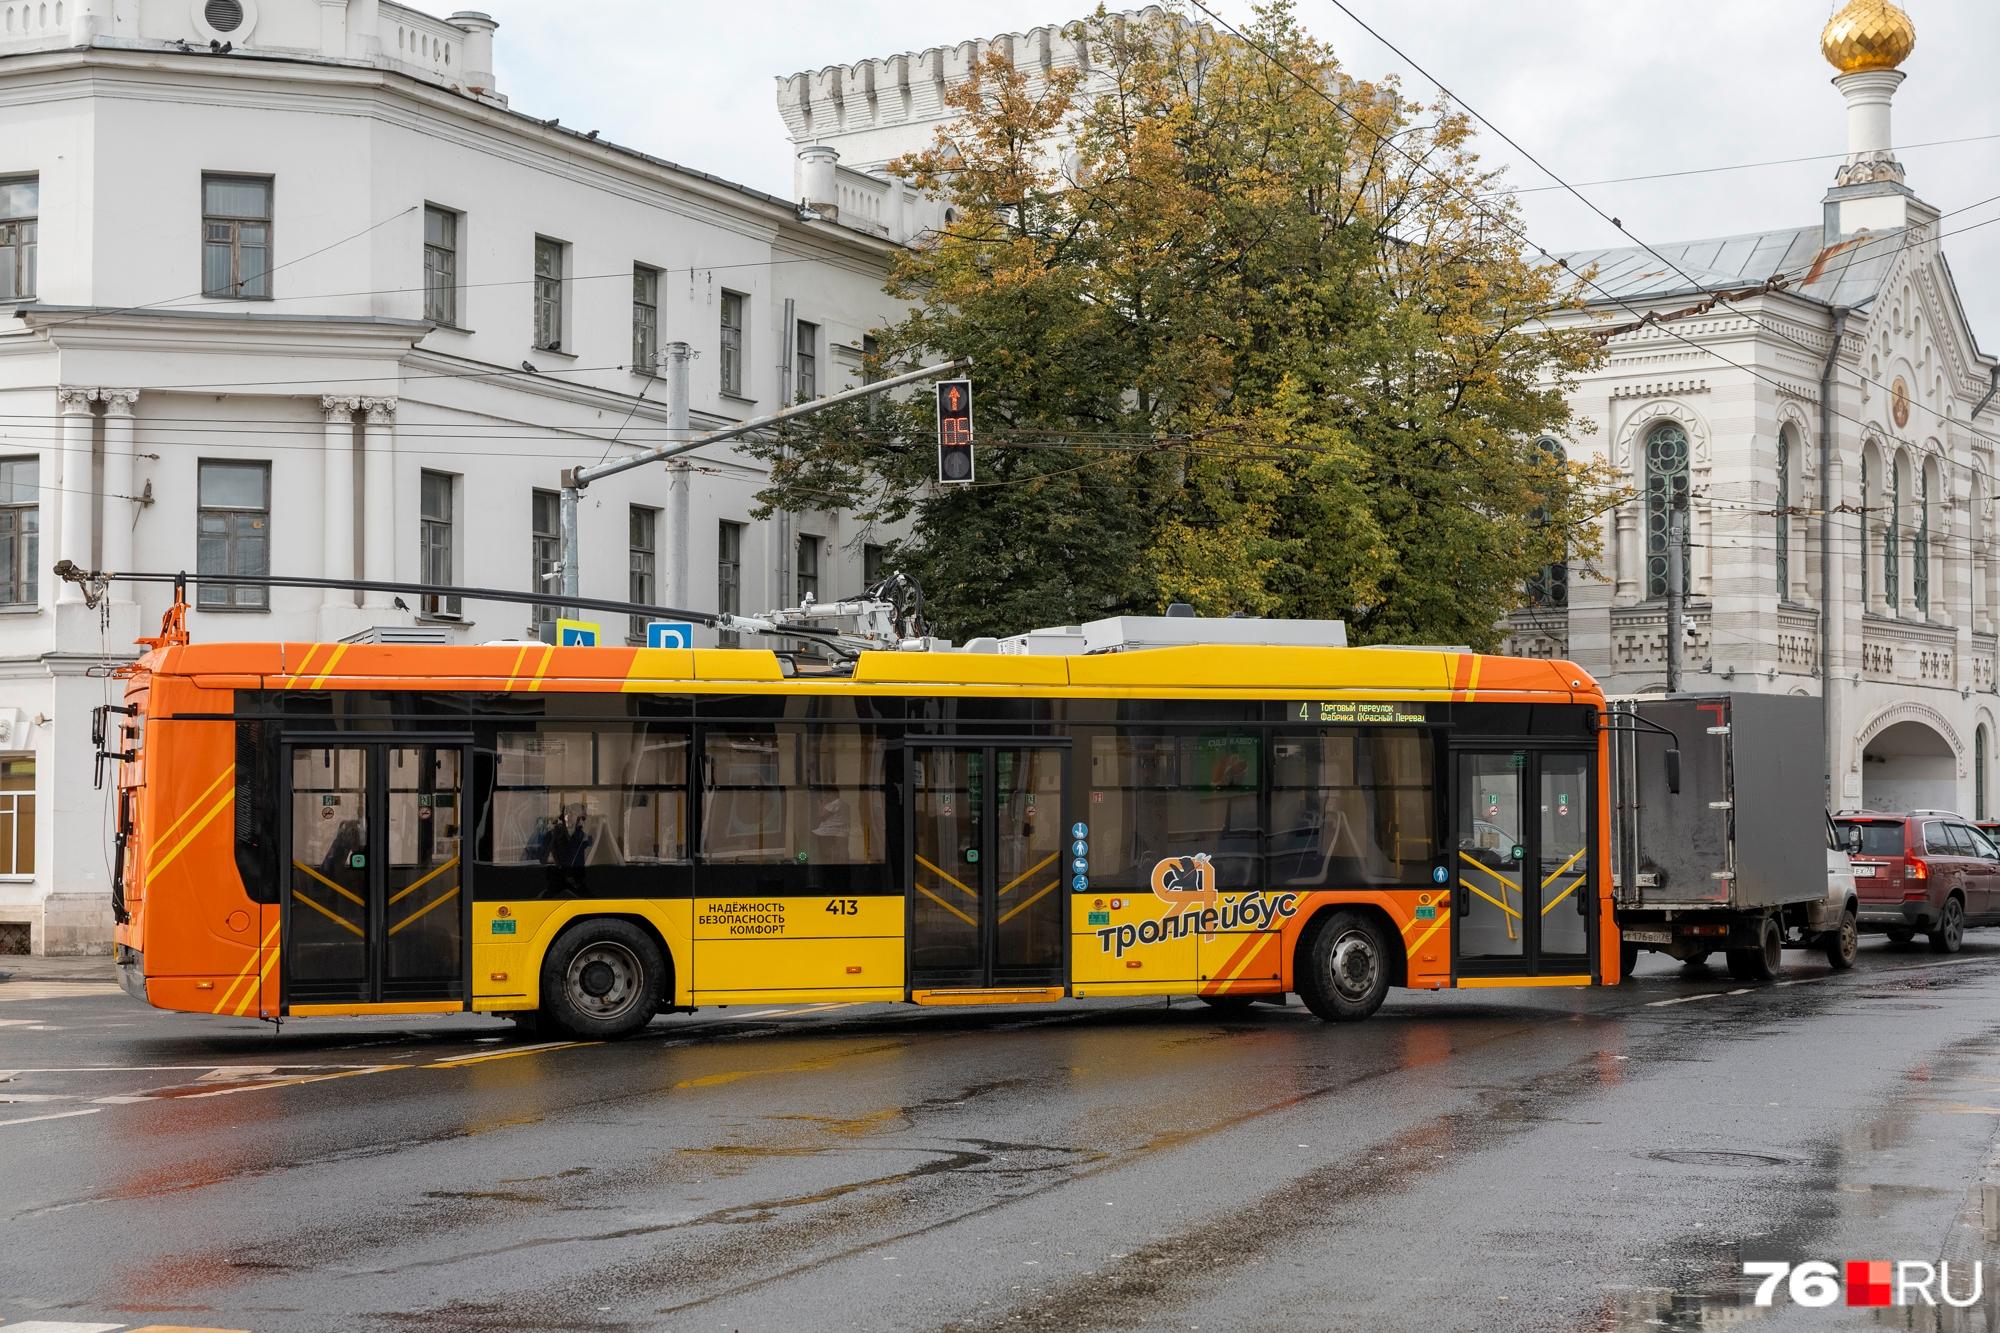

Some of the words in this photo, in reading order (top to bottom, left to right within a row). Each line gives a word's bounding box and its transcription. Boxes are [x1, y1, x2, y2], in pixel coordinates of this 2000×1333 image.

[944, 417, 969, 445] 05
[1299, 702, 1309, 720] 4
[1320, 702, 1356, 712] Торговый
[1358, 704, 1394, 713] переулок
[1320, 712, 1354, 721] Фабрика
[708, 902, 785, 914] НАДЁЖНОСТЬ
[825, 899, 858, 916] 413
[699, 914, 785, 925] БЕЗОПАСНОСТЬ
[1097, 891, 1298, 958] троллейбус
[730, 925, 785, 935] КОМФОРТ
